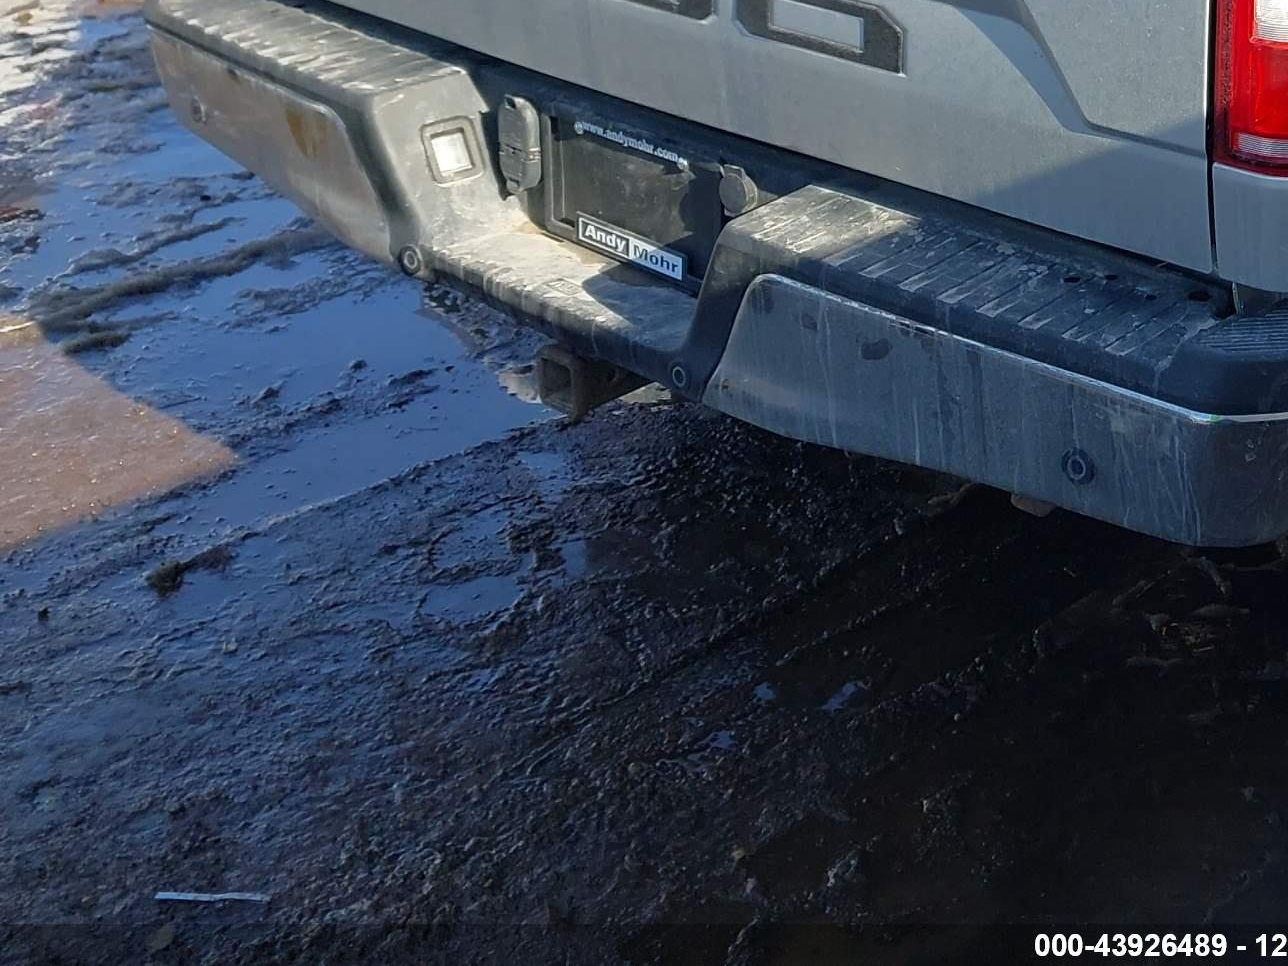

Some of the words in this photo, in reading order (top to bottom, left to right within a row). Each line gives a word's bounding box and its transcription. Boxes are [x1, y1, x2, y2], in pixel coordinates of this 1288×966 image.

[583, 122, 679, 163] www.andymohr.com
[585, 225, 627, 251] Andy
[633, 244, 679, 273] Mohr
